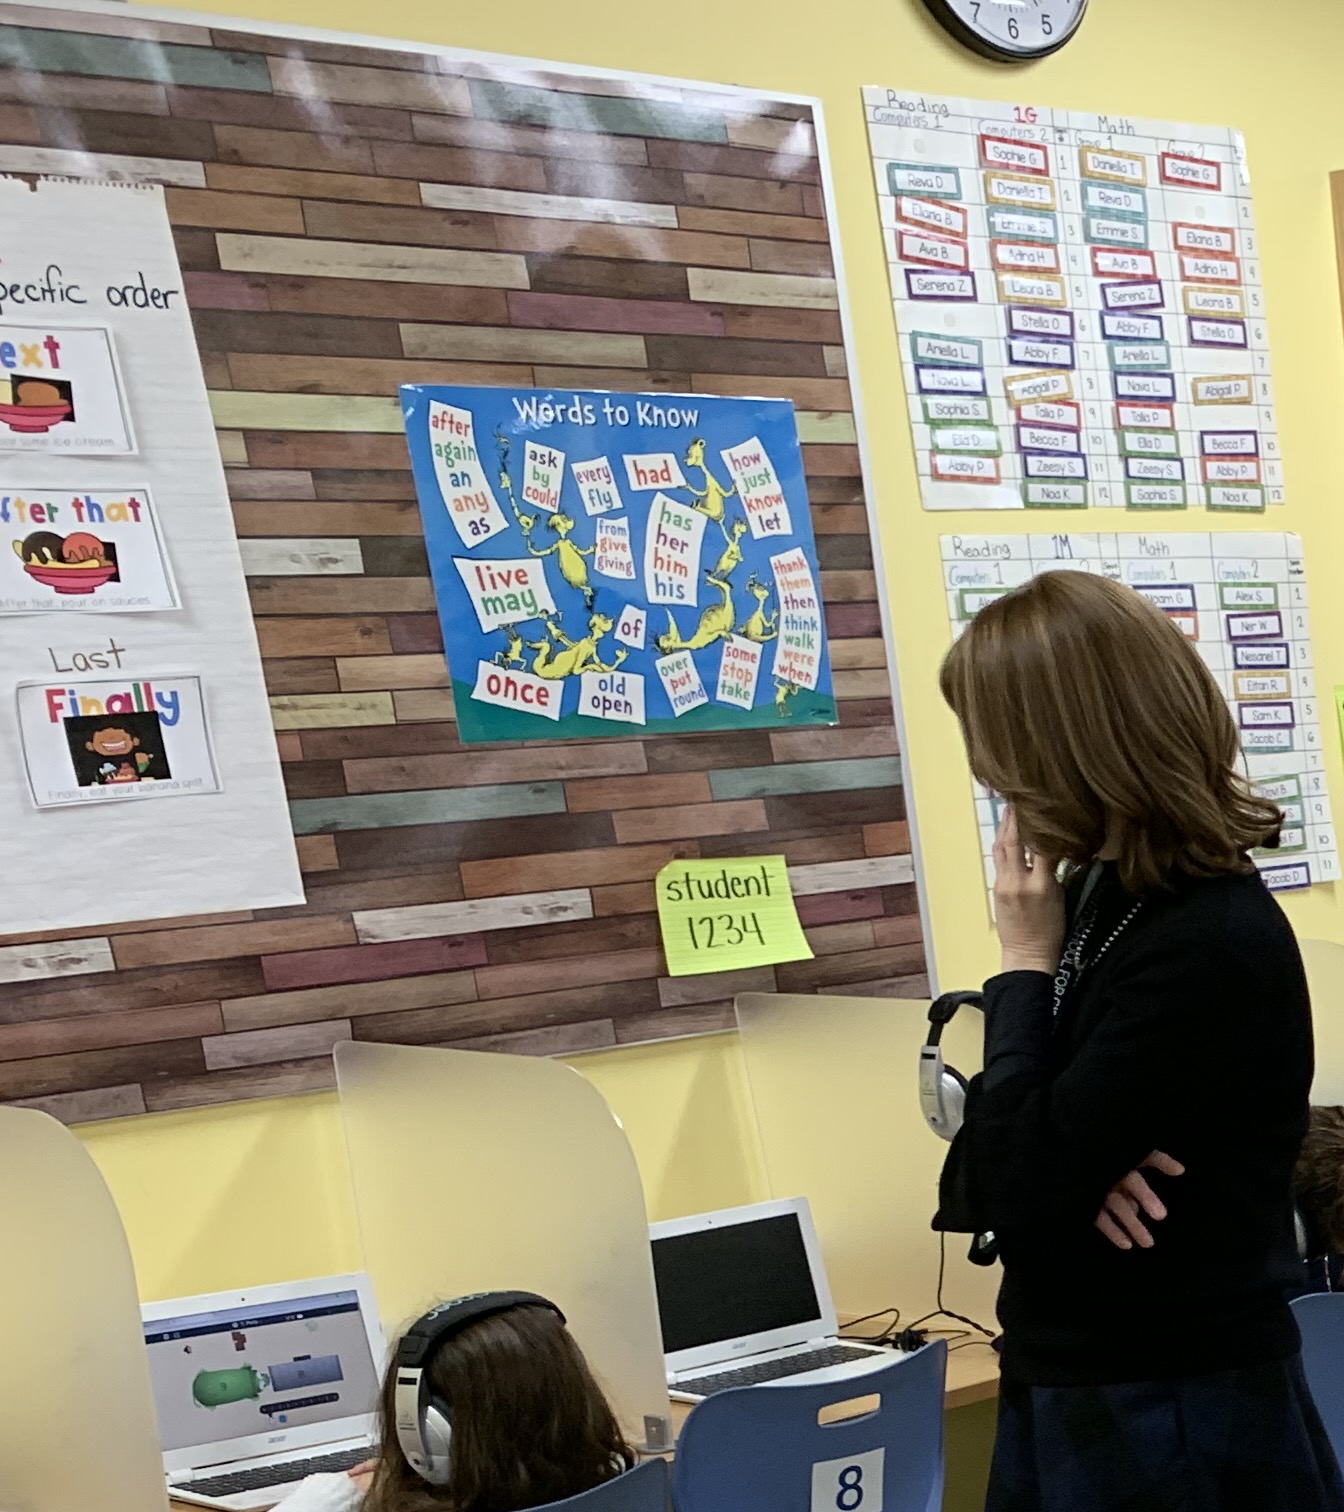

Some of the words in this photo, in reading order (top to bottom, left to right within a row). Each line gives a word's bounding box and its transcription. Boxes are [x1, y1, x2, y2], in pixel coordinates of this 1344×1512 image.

[970, 1, 980, 23] 7
[1008, 18, 1019, 39] 6
[1041, 14, 1053, 35] 5
[887, 89, 950, 118] Reading
[1098, 116, 1135, 136] Math
[106, 271, 179, 309] order
[1021, 315, 1049, 329] Stella
[512, 397, 596, 428] Words
[603, 401, 629, 427] to
[638, 402, 698, 428] Know
[432, 413, 470, 436] after
[435, 442, 476, 467] again
[529, 450, 558, 469] ask
[729, 452, 761, 470] how
[450, 471, 472, 488] an
[532, 466, 550, 487] by
[576, 466, 610, 493] every
[633, 461, 671, 484] had
[739, 468, 772, 493] just
[453, 492, 489, 514] any
[525, 486, 558, 508] could
[588, 488, 614, 509] fly
[744, 493, 783, 510] know
[72, 496, 141, 523] that
[660, 502, 693, 531] has
[468, 517, 491, 536] as
[599, 522, 627, 537] from
[759, 514, 780, 531] let
[600, 537, 628, 555] give
[655, 529, 689, 555] her
[952, 535, 1011, 559] Reading
[1138, 536, 1170, 557] Math
[598, 554, 633, 577] giving
[653, 552, 688, 578] him
[774, 560, 807, 574] thank
[476, 565, 529, 591] live
[655, 577, 685, 600] his
[780, 576, 810, 591] them
[482, 590, 540, 618] may
[784, 594, 816, 610] then
[1235, 589, 1253, 602] Alex
[621, 618, 642, 638] of
[785, 615, 819, 632] think
[785, 633, 815, 650] walk
[48, 640, 125, 672] Last
[724, 645, 757, 664] some
[784, 648, 815, 666] were
[660, 656, 689, 676] over
[721, 663, 753, 684] stop
[778, 662, 813, 683] when
[487, 673, 549, 707] once
[598, 674, 626, 694] old
[670, 671, 693, 691] put
[721, 681, 751, 701] take
[45, 682, 180, 726] Finally
[591, 693, 633, 716] open
[672, 683, 706, 707] round
[1252, 708, 1270, 721] Sam
[667, 865, 775, 901] student
[688, 912, 765, 949] 1234
[836, 1465, 863, 1511] 8
